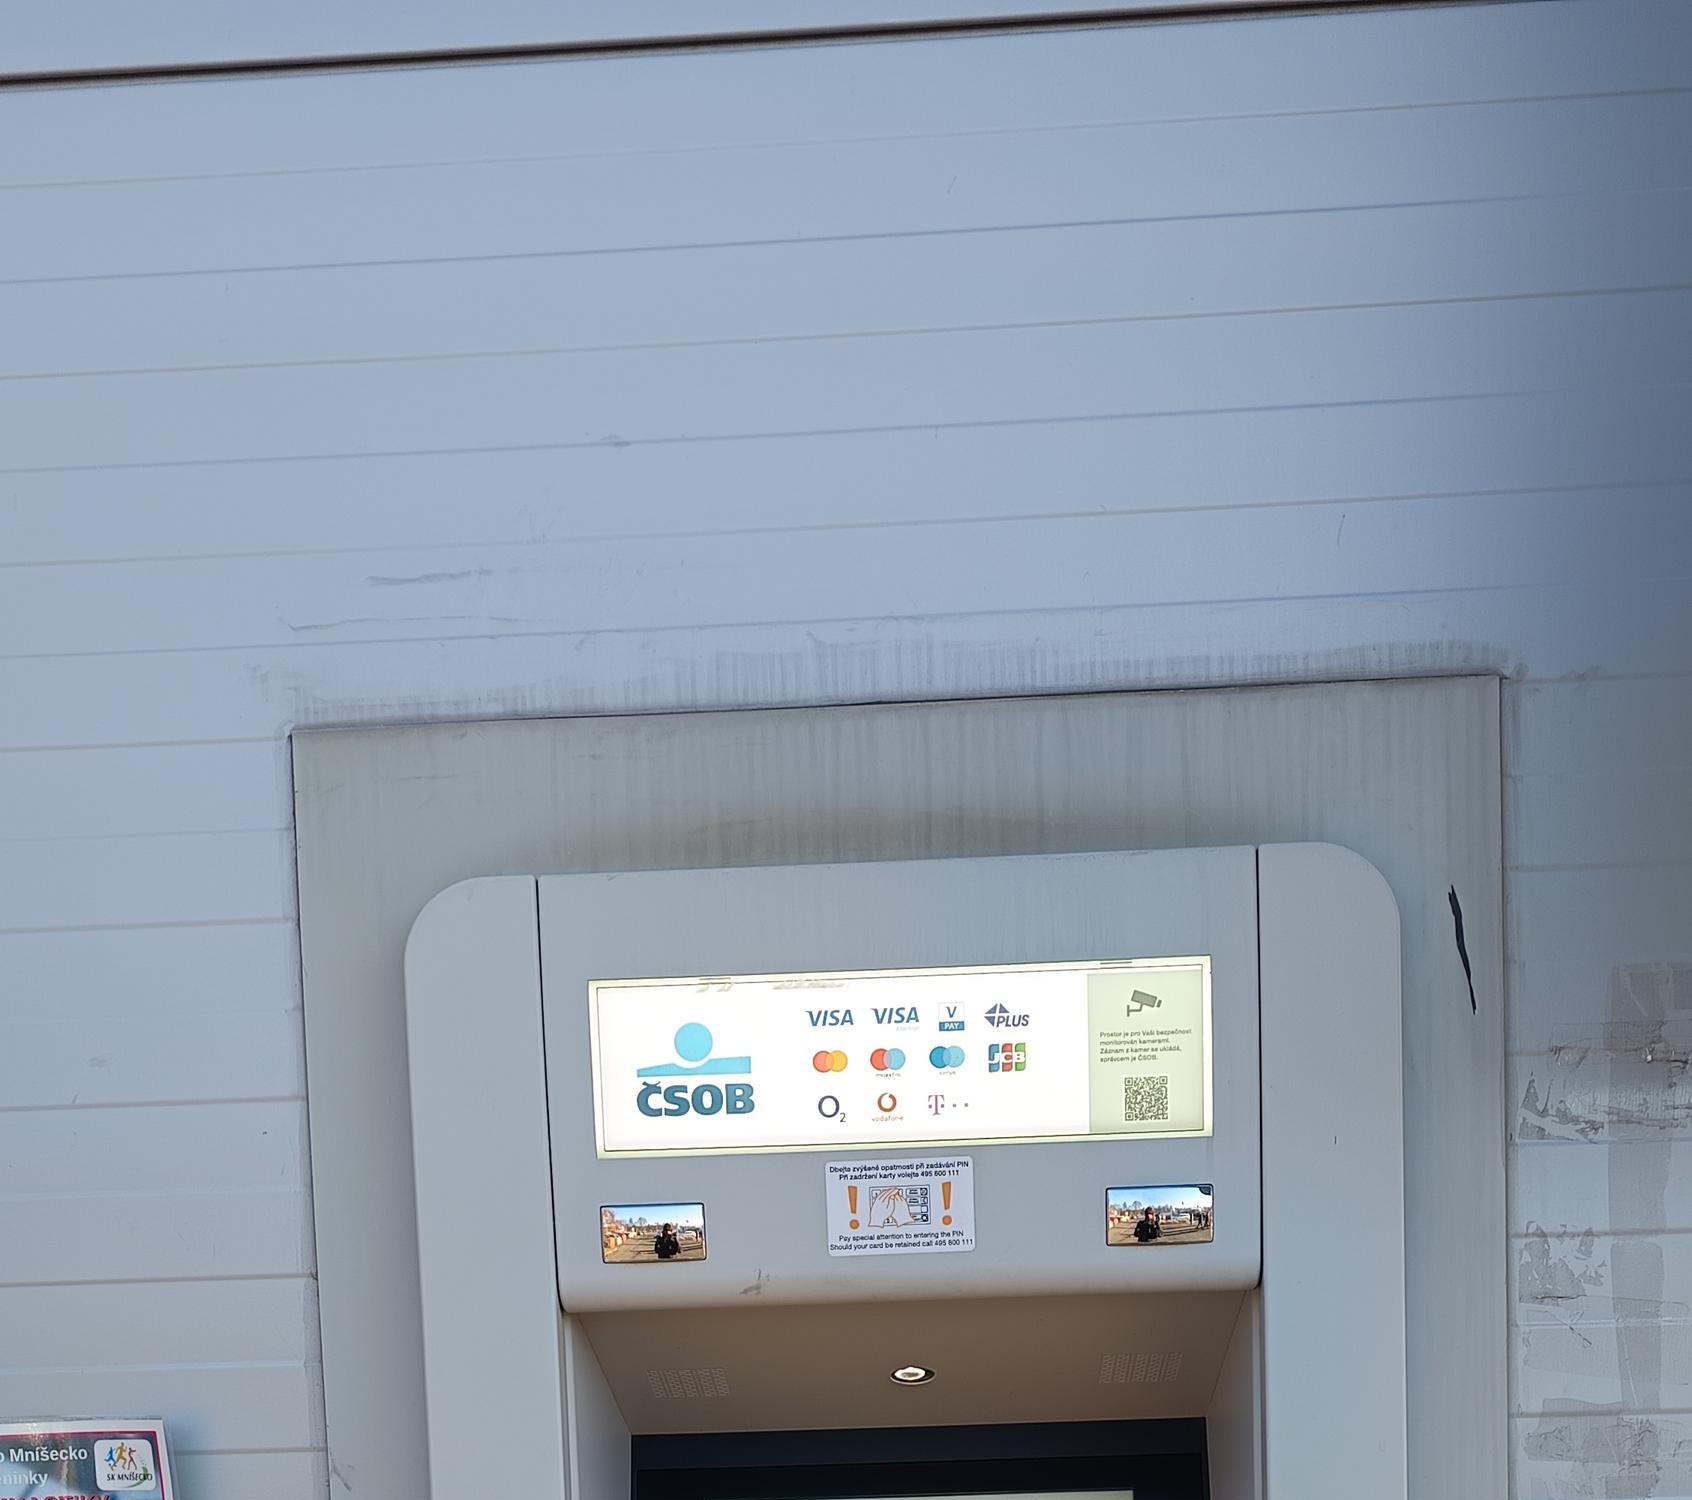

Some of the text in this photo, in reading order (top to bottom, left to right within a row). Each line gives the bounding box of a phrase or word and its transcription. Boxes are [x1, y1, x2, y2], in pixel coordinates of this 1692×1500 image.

[805, 1009, 854, 1027] VISA
[870, 1006, 920, 1024] VISA
[946, 1006, 957, 1018] V
[944, 1021, 959, 1030] PAY
[996, 1014, 1029, 1028] PLUS
[1156, 1028, 1192, 1036] bezpečnost
[988, 1047, 1026, 1068] JCB
[1100, 1055, 1130, 1063] správcem
[636, 1081, 755, 1118] ČSOB
[829, 1166, 851, 1174] Dbejte
[852, 1165, 879, 1173] zvýšené
[881, 1163, 914, 1172] opatrnosti
[915, 1162, 925, 1170] při
[926, 1161, 956, 1169] zadávání
[839, 1173, 849, 1181] Při
[849, 1172, 878, 1180] zadržení
[879, 1172, 896, 1181] karty
[897, 1170, 920, 1179] volejte
[838, 1235, 852, 1243] Pay
[852, 1234, 875, 1242] special
[913, 1232, 939, 1240] entering
[830, 1243, 852, 1251] Should
[853, 1244, 868, 1252] your
[934, 1239, 947, 1247] 495
[9, 1445, 88, 1462] Mníšecko
[118, 1472, 153, 1481] MNÍŠECKO
